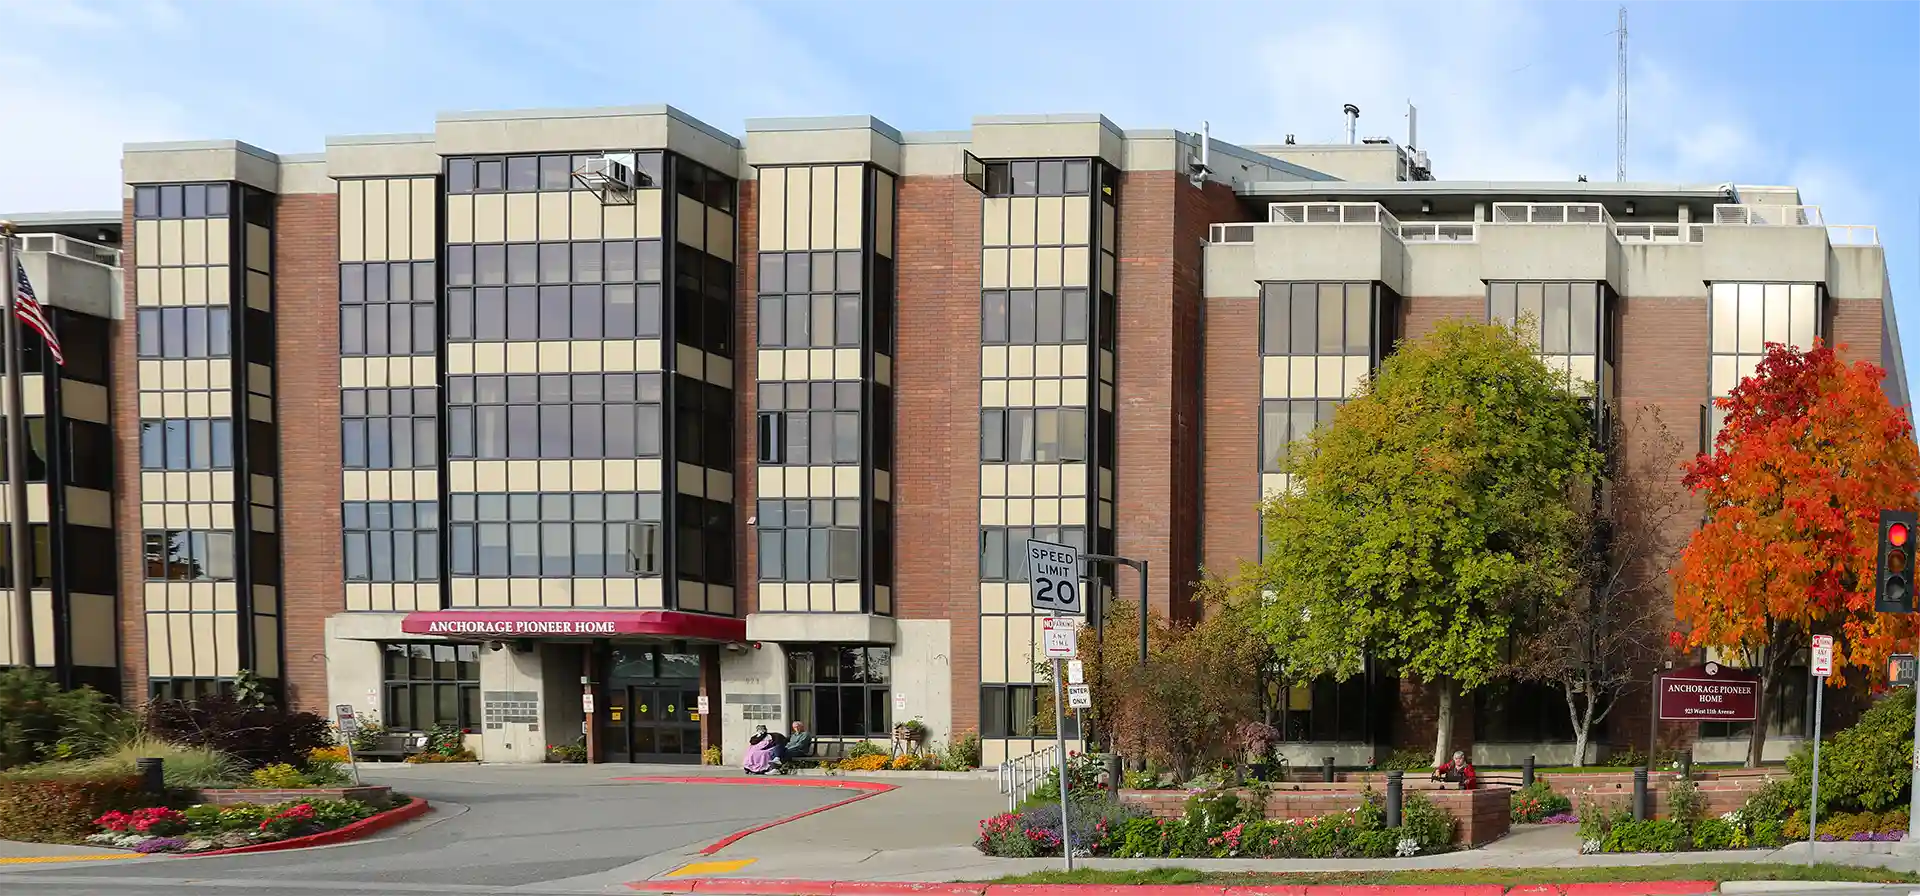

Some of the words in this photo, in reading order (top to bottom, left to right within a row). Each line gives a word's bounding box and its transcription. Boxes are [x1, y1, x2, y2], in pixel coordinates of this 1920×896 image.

[1032, 548, 1074, 565] SPEED
[1037, 562, 1070, 577] LIMIT
[1036, 577, 1075, 604] 20
[429, 621, 513, 633] ANCHORAGE
[516, 621, 572, 633] PIONEER
[575, 621, 615, 633] HOME
[1043, 620, 1053, 629] NO
[1668, 684, 1719, 693] ANCHORAGE
[1720, 686, 1751, 694] PIONEER
[1699, 695, 1723, 703] HOME
